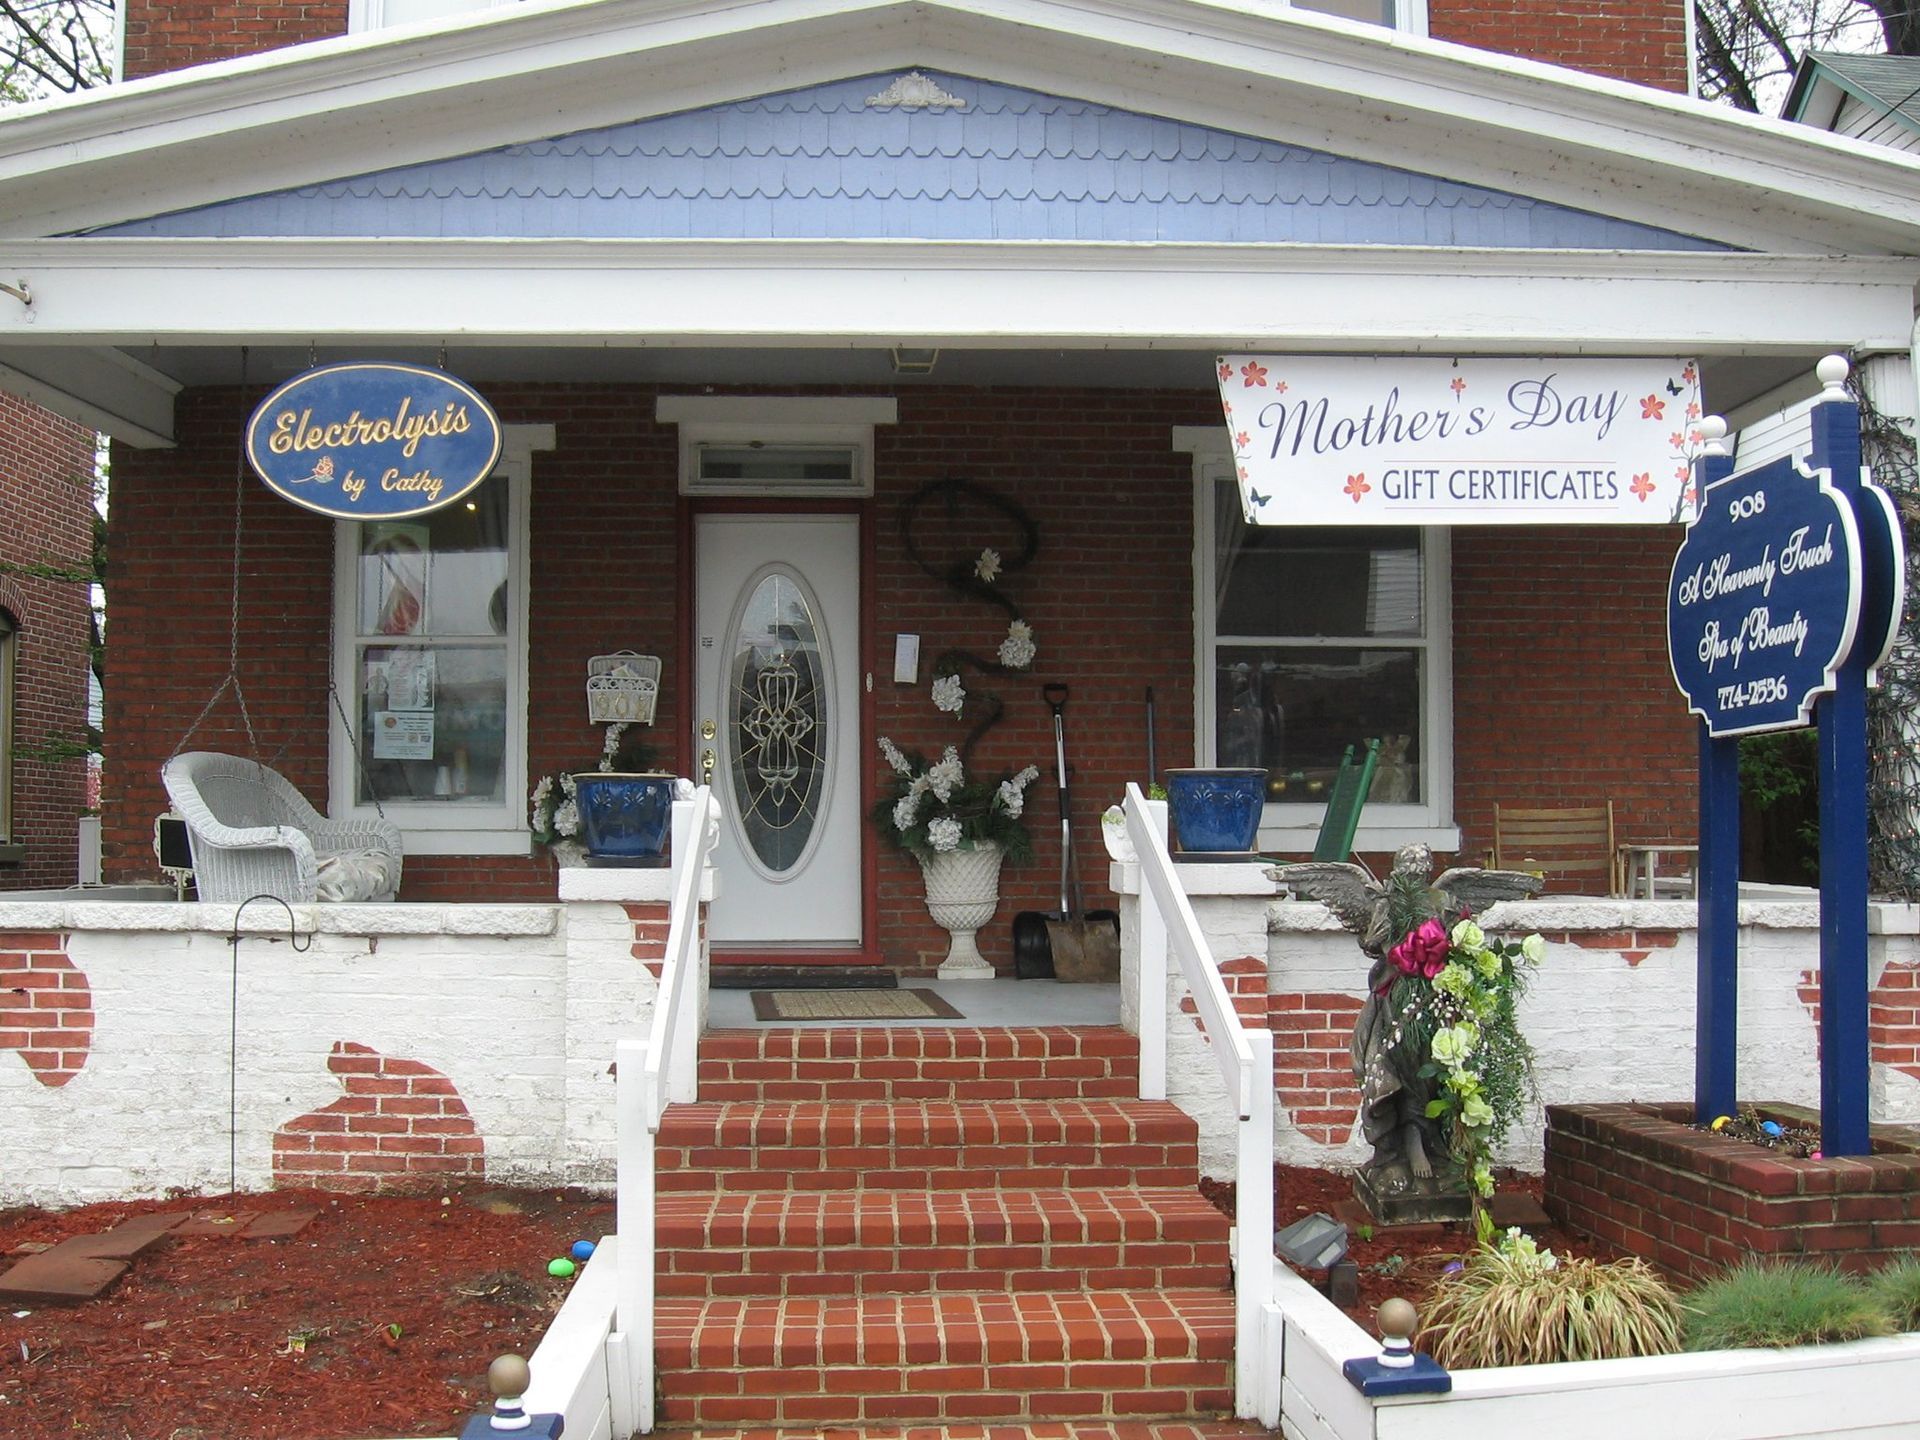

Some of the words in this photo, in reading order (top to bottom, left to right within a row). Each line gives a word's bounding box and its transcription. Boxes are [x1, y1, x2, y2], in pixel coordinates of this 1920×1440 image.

[269, 396, 471, 457] Electrolysis
[1258, 386, 1496, 460] Mother's
[1507, 373, 1628, 440] Day
[342, 469, 366, 501] by
[381, 468, 444, 501] Cathy
[1382, 469, 1439, 501] GIFT
[1448, 469, 1619, 501] CERTIFICATES
[1729, 490, 1766, 523] 908
[1679, 562, 1704, 606] A
[1702, 544, 1776, 600] Heavenly
[1780, 523, 1833, 575] Touch
[1698, 621, 1728, 673] Spa
[1730, 617, 1749, 669] of
[1748, 606, 1808, 657] Beauty
[1717, 675, 1788, 711] 774-2536
